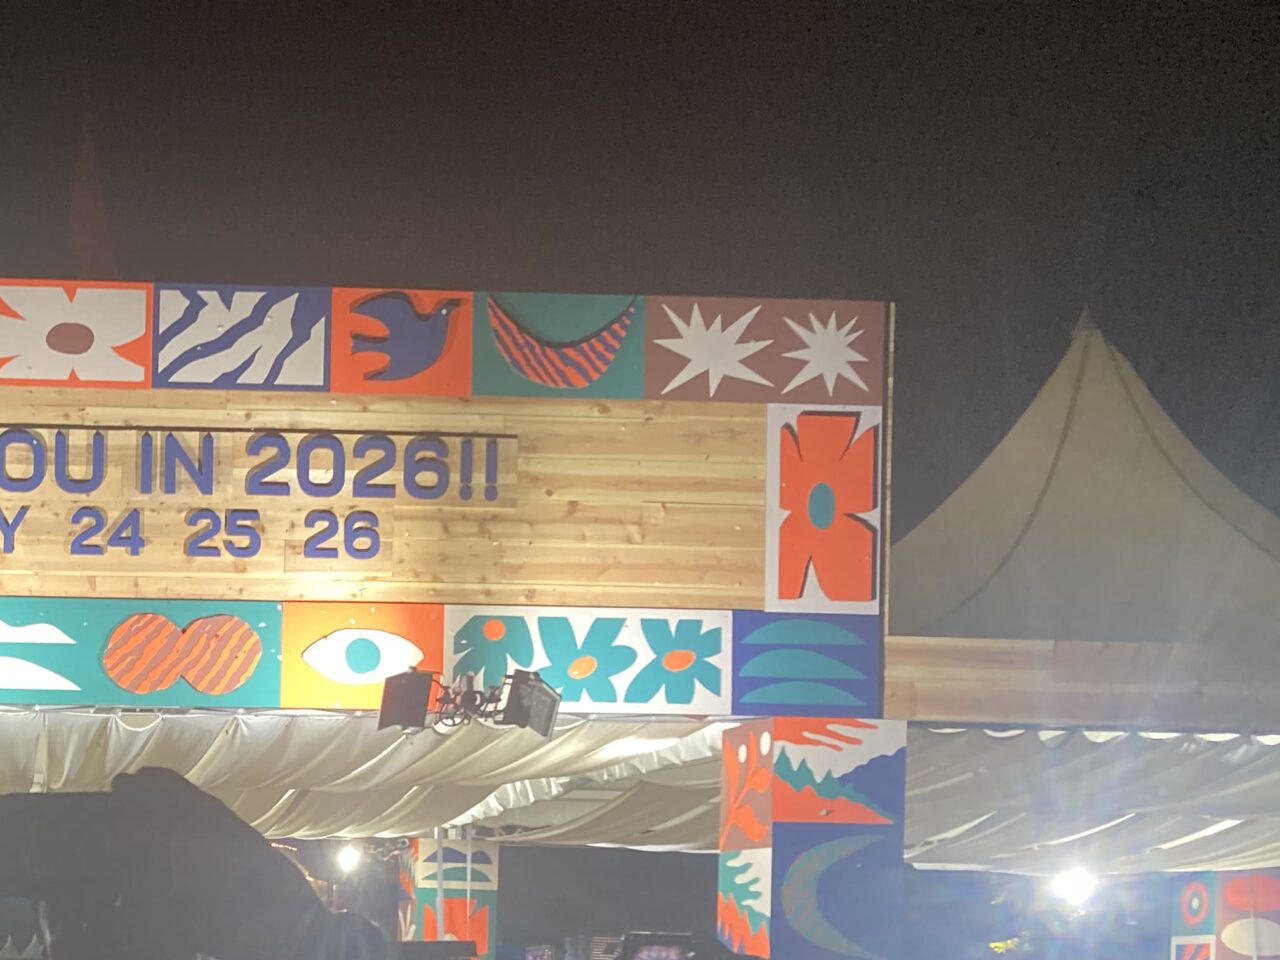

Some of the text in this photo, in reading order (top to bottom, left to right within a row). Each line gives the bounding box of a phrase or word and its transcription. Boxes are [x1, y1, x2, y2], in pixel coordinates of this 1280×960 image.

[138, 430, 214, 495] IN
[245, 432, 498, 501] 2026!!
[70, 506, 145, 556] 24
[185, 508, 261, 558] 25
[304, 510, 380, 560] 26
